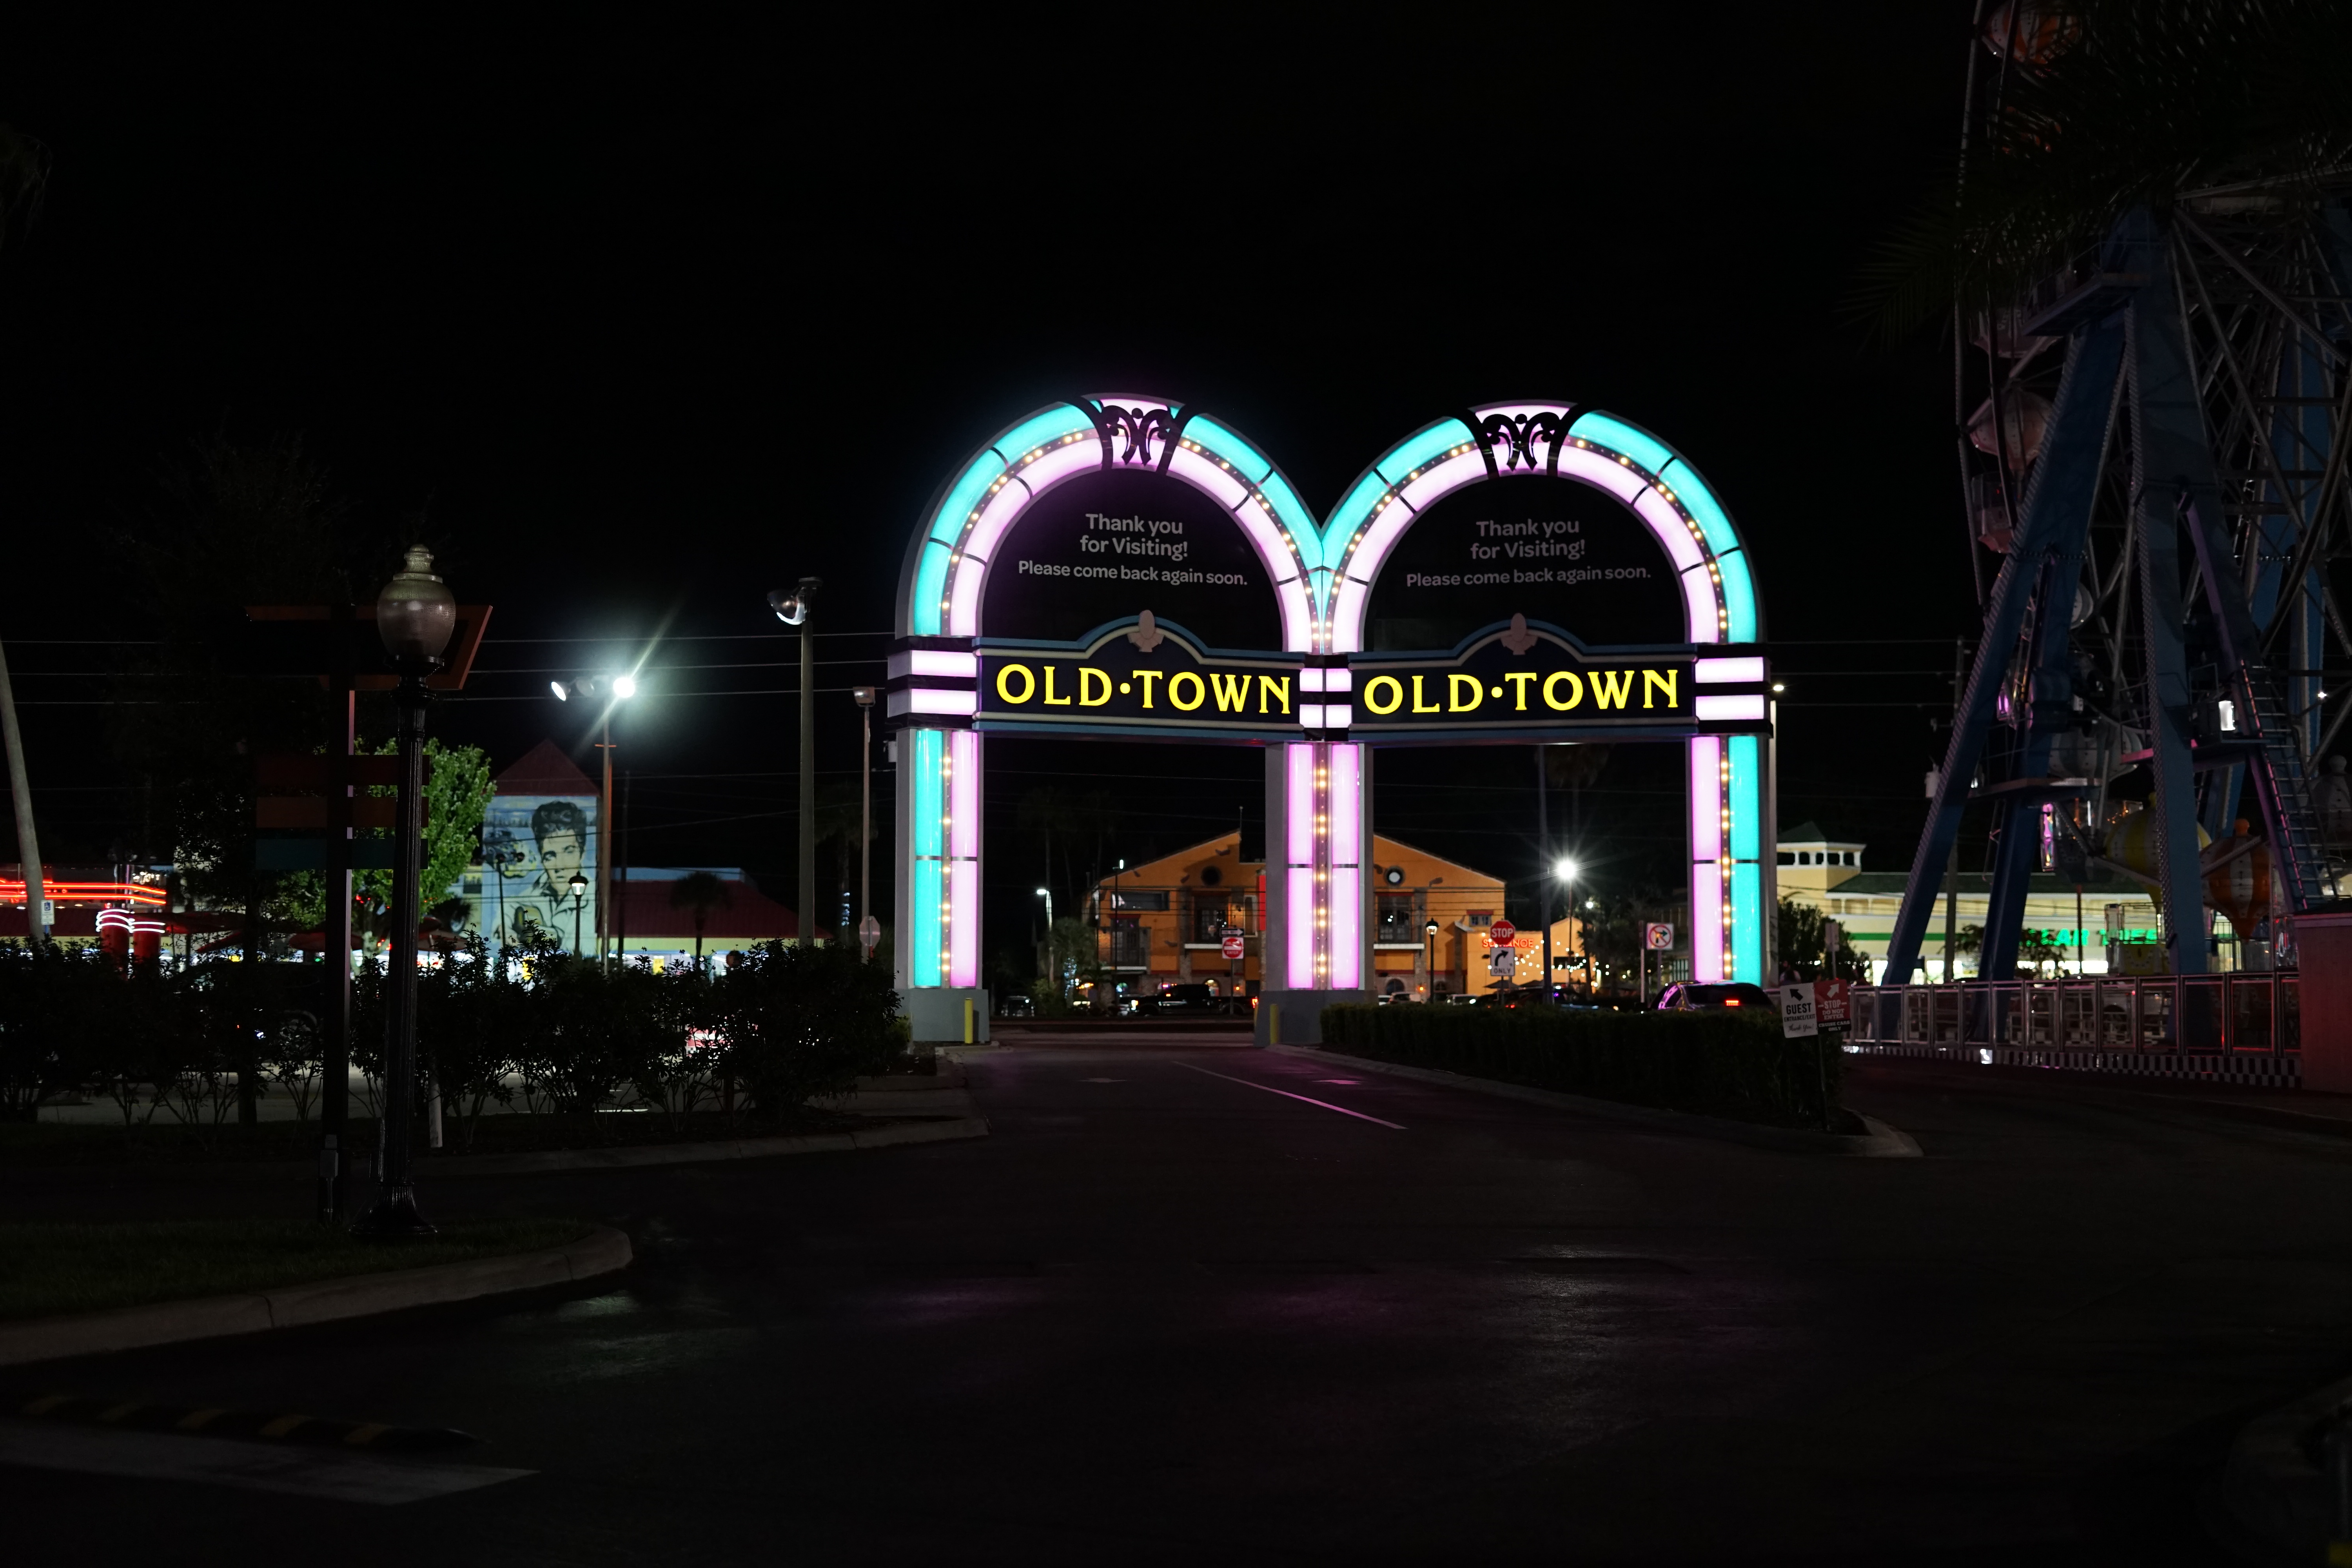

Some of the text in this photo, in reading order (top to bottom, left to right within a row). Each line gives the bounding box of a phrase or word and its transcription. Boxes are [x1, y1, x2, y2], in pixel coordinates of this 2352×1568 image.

[1085, 513, 1182, 537] Thank you
[1476, 519, 1579, 538] Thank you
[1080, 535, 1187, 561] for Visiting!
[1470, 539, 1585, 560] for Visiting!
[1019, 560, 1247, 585] Please come back again soon.
[1407, 566, 1651, 587] Please come back again soon.
[1491, 927, 1514, 938] STOP
[1786, 1003, 1811, 1014] GUEST
[1824, 999, 1841, 1009] STOP
[1784, 1014, 1815, 1022] ENTRANCE/EXIT
